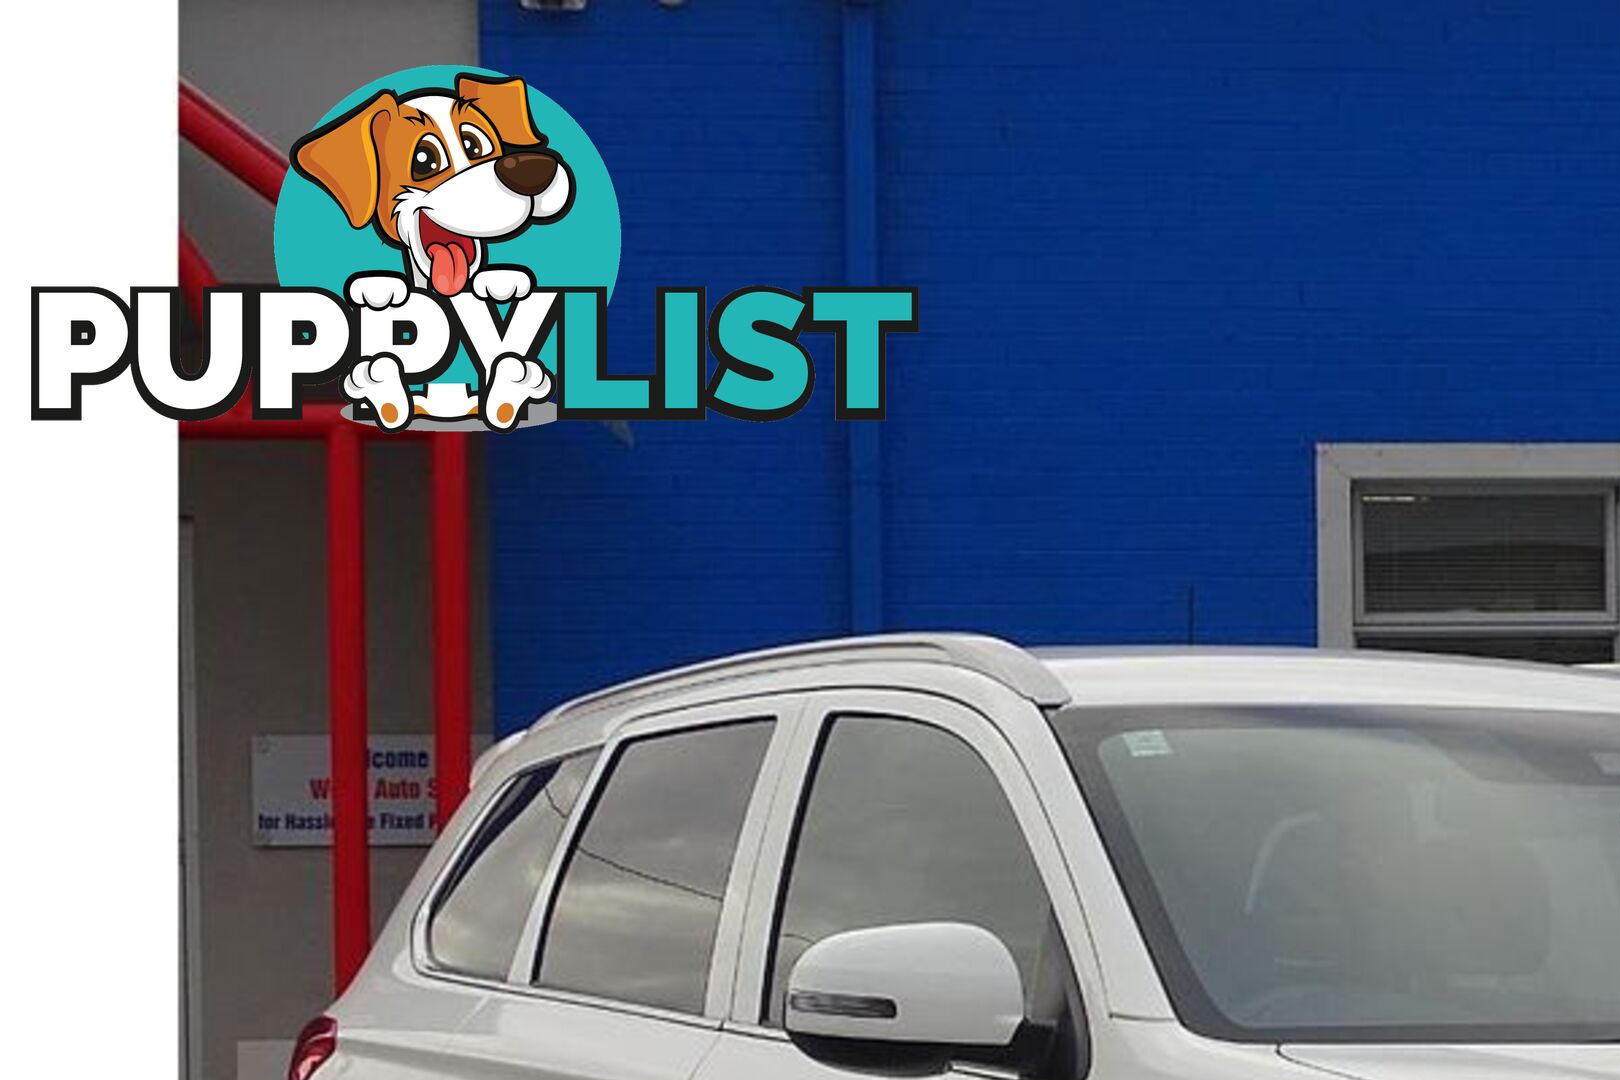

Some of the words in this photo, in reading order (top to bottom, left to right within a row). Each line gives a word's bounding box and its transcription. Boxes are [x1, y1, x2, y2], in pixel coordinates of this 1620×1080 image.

[366, 749, 430, 769] lcome
[374, 778, 421, 800] Auto
[258, 813, 280, 830] for
[285, 812, 333, 830] Hassl
[380, 812, 425, 830] Fixed
